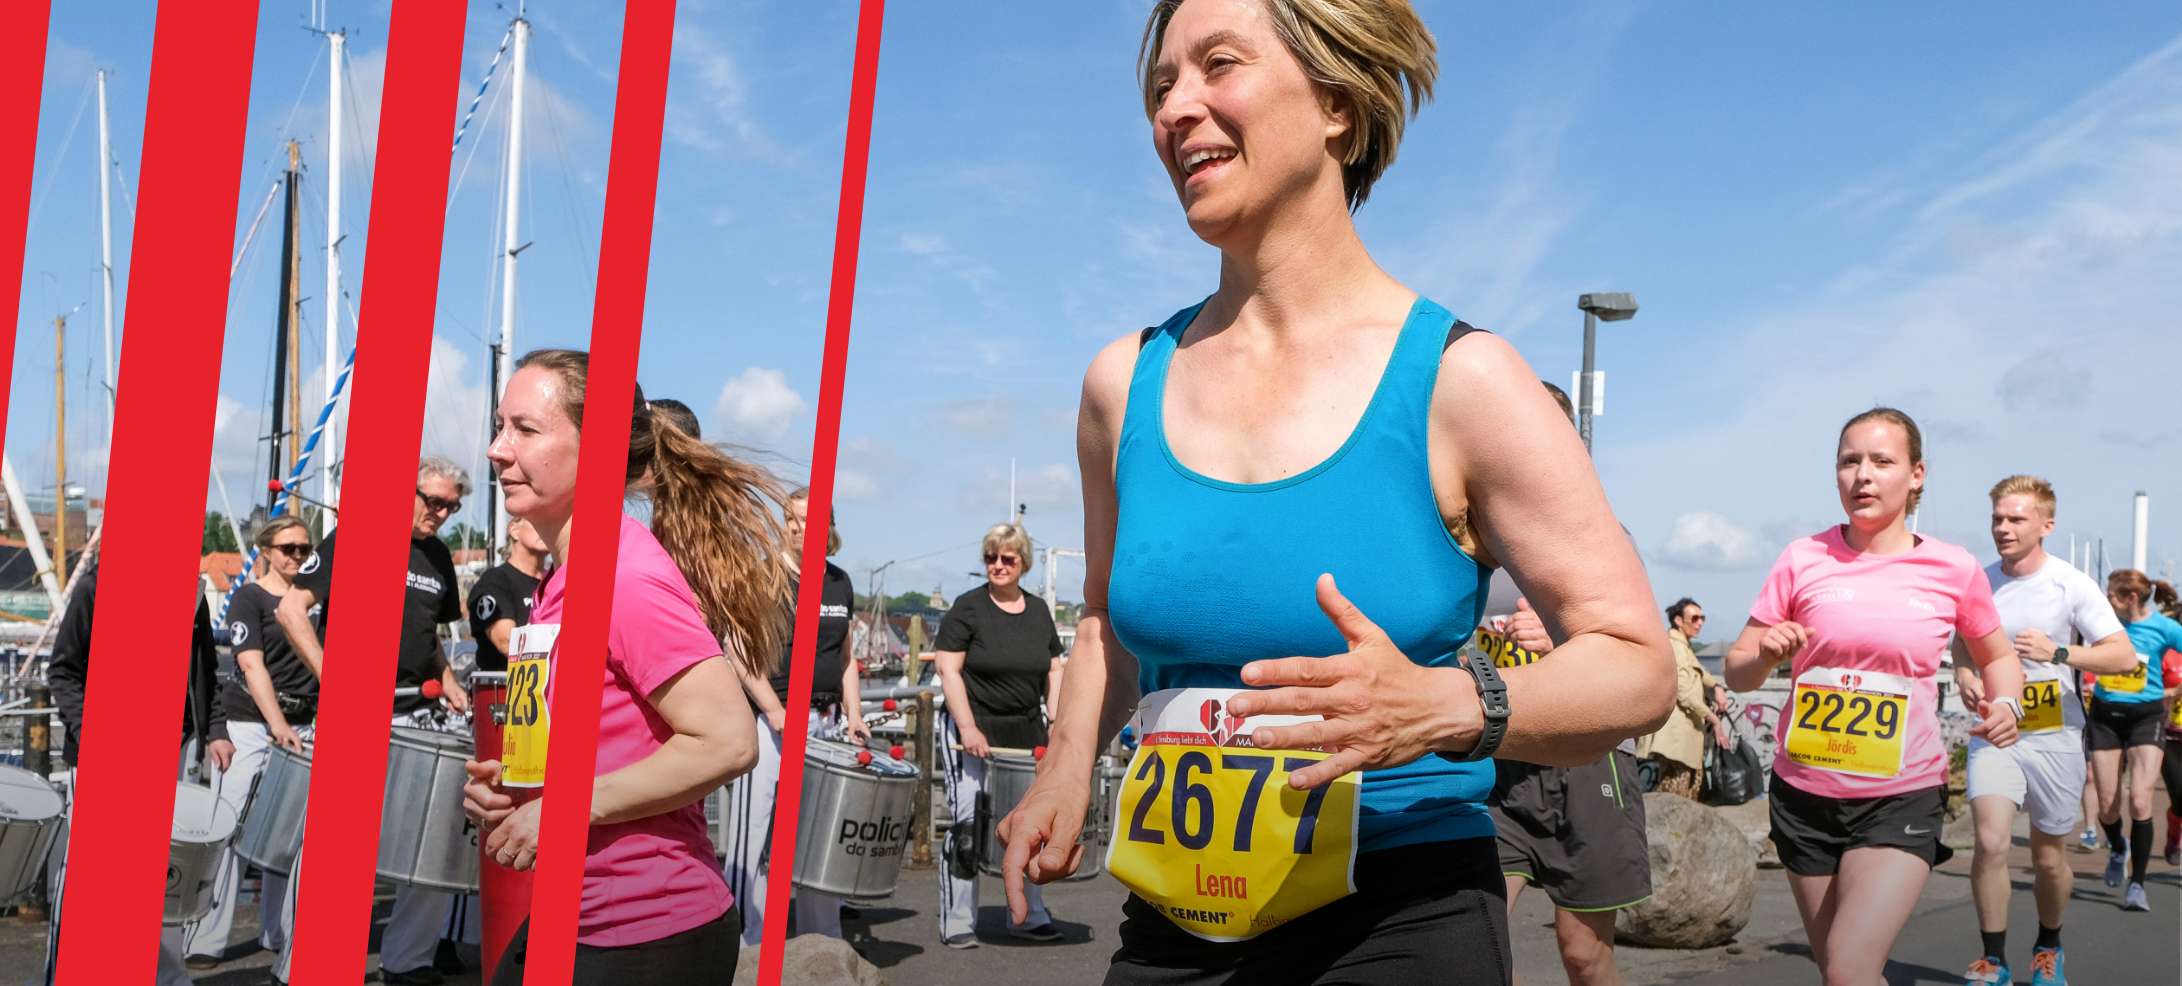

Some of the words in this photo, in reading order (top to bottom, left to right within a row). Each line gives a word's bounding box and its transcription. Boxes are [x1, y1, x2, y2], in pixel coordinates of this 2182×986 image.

[1798, 691, 1899, 739] 2229
[2023, 684, 2056, 710] 94
[1128, 751, 1334, 854] 2677
[870, 845, 900, 858] samb
[1195, 863, 1248, 899] Lena
